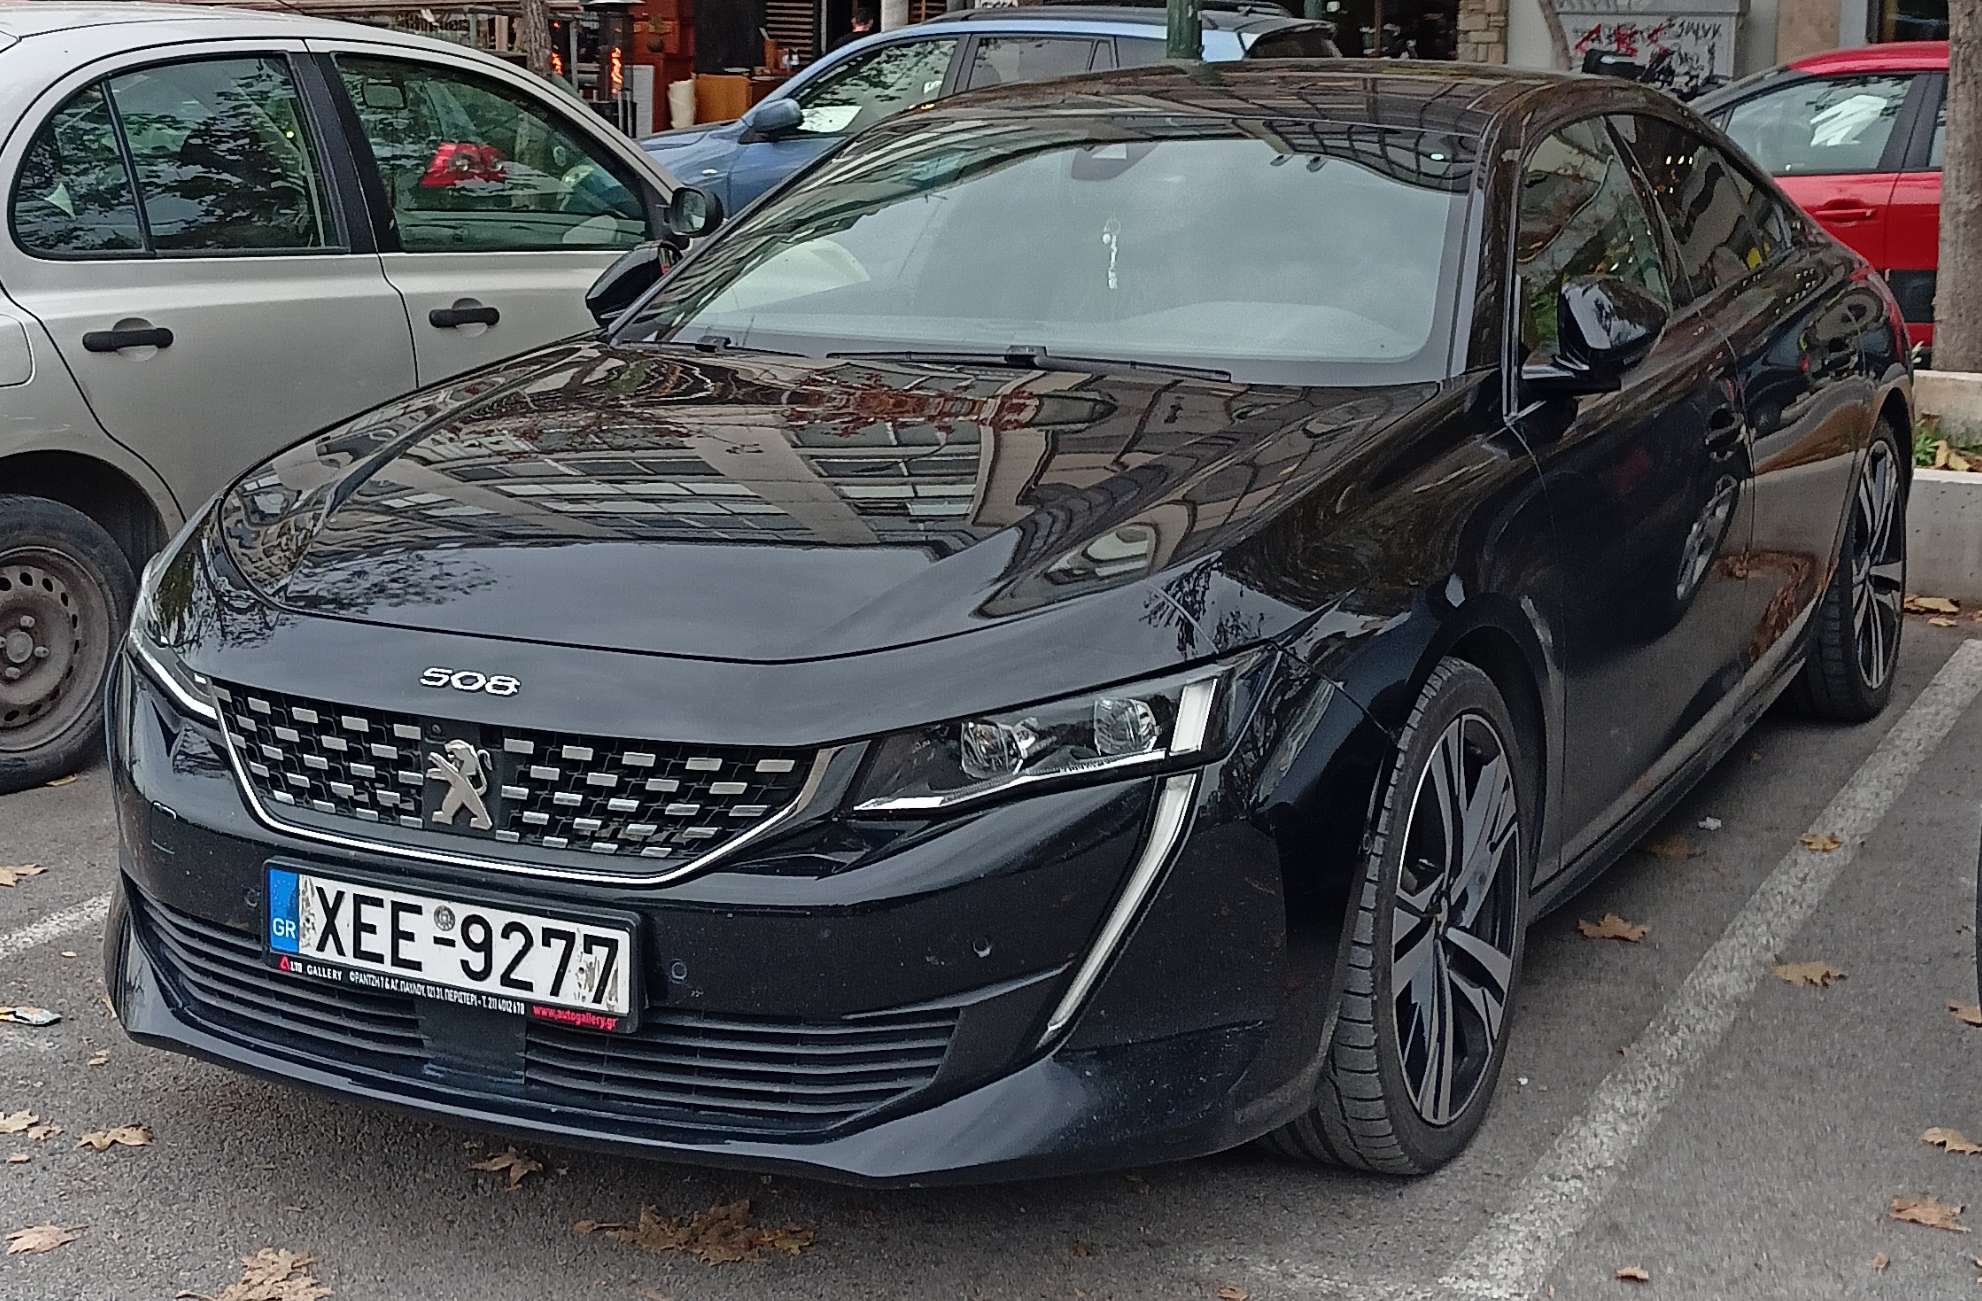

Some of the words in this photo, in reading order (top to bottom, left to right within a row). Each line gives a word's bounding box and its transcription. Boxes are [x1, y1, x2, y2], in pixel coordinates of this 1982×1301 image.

[420, 667, 521, 696] 508
[272, 917, 297, 940] GR
[306, 964, 342, 982] GALLERY
[533, 1005, 618, 1031] www.autogallery.gr
